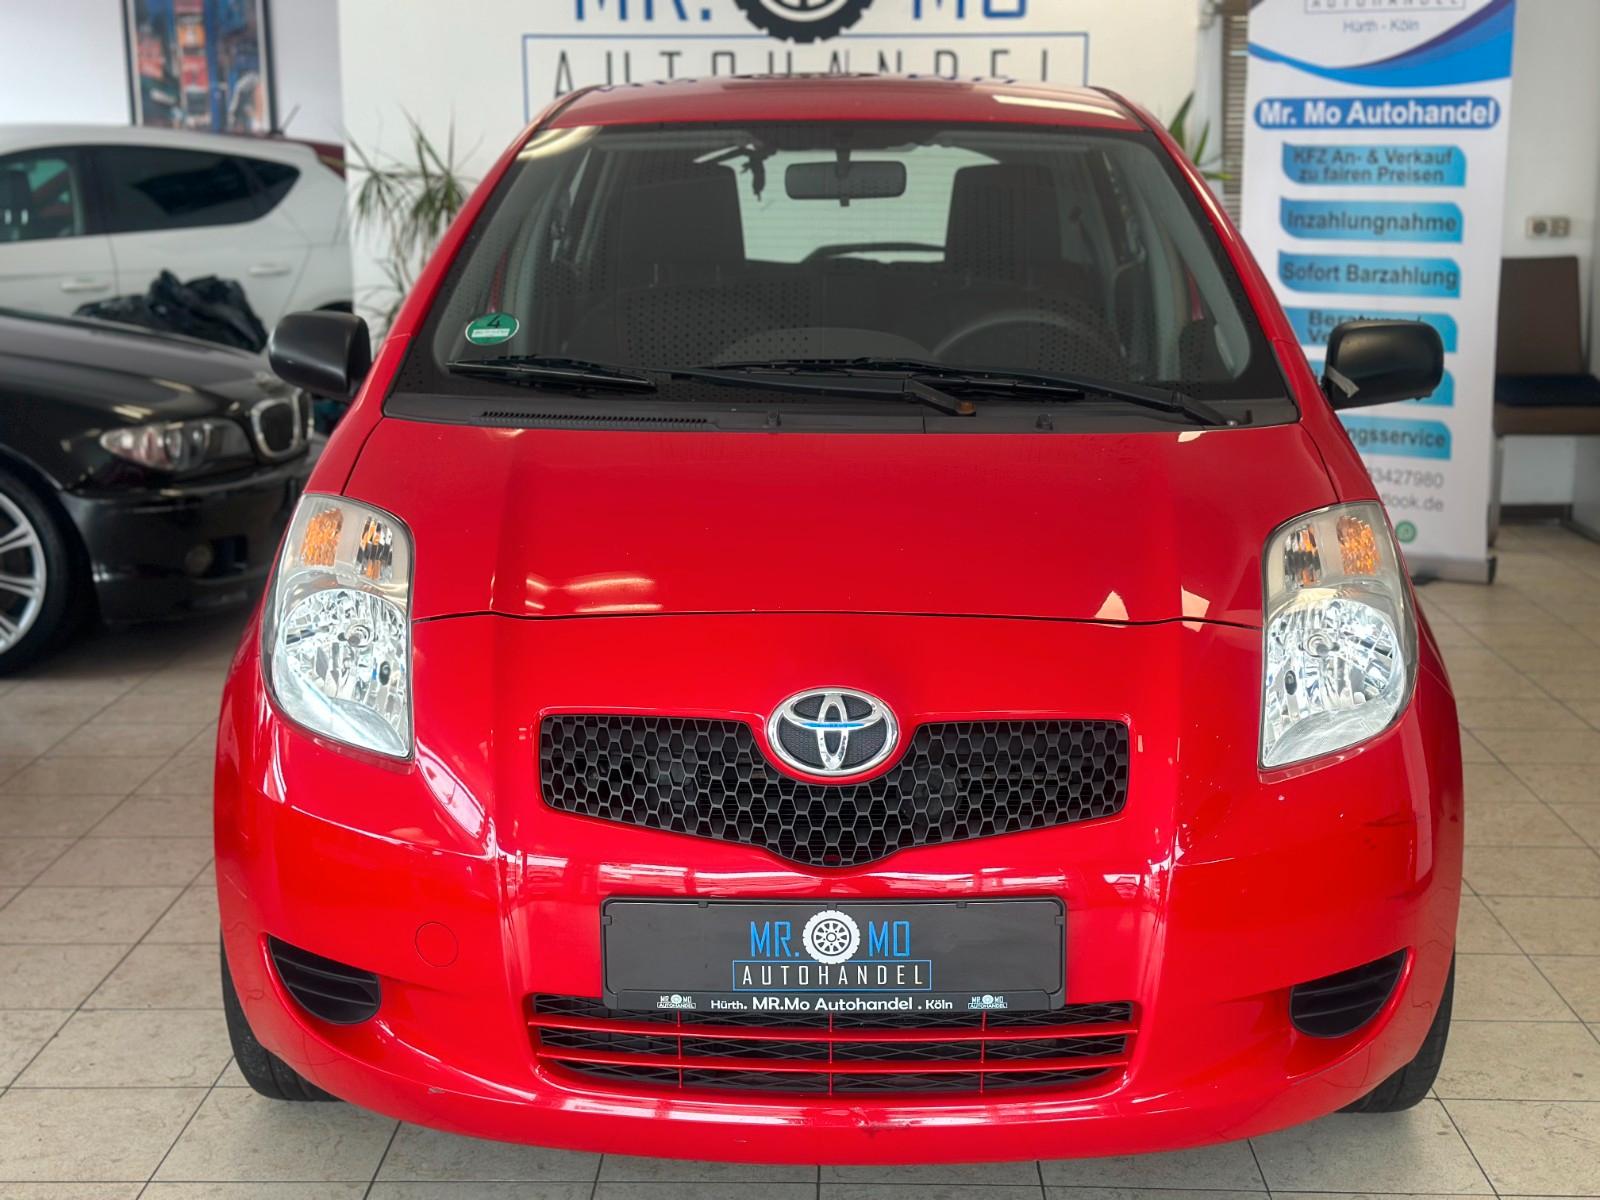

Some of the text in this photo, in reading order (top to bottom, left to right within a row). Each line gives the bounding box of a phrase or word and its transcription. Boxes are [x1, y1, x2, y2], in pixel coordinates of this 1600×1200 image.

[1260, 100, 1495, 125] Mr. Mo Autohandel
[1293, 147, 1453, 165] KFZ An- & Verkauf
[1300, 166, 1444, 183] zu fairen Preisen
[1288, 210, 1457, 235] Inzahlungnahme
[1283, 262, 1457, 289] Sofort Barzahlung
[487, 315, 501, 328] 4
[750, 921, 910, 957] MR. MO
[743, 965, 923, 985] AUTOHANDEL
[711, 1000, 748, 1010] Hürth.
[752, 997, 810, 1010] MR.Mo
[814, 997, 913, 1011] Autohandel
[925, 999, 953, 1010] Köln
